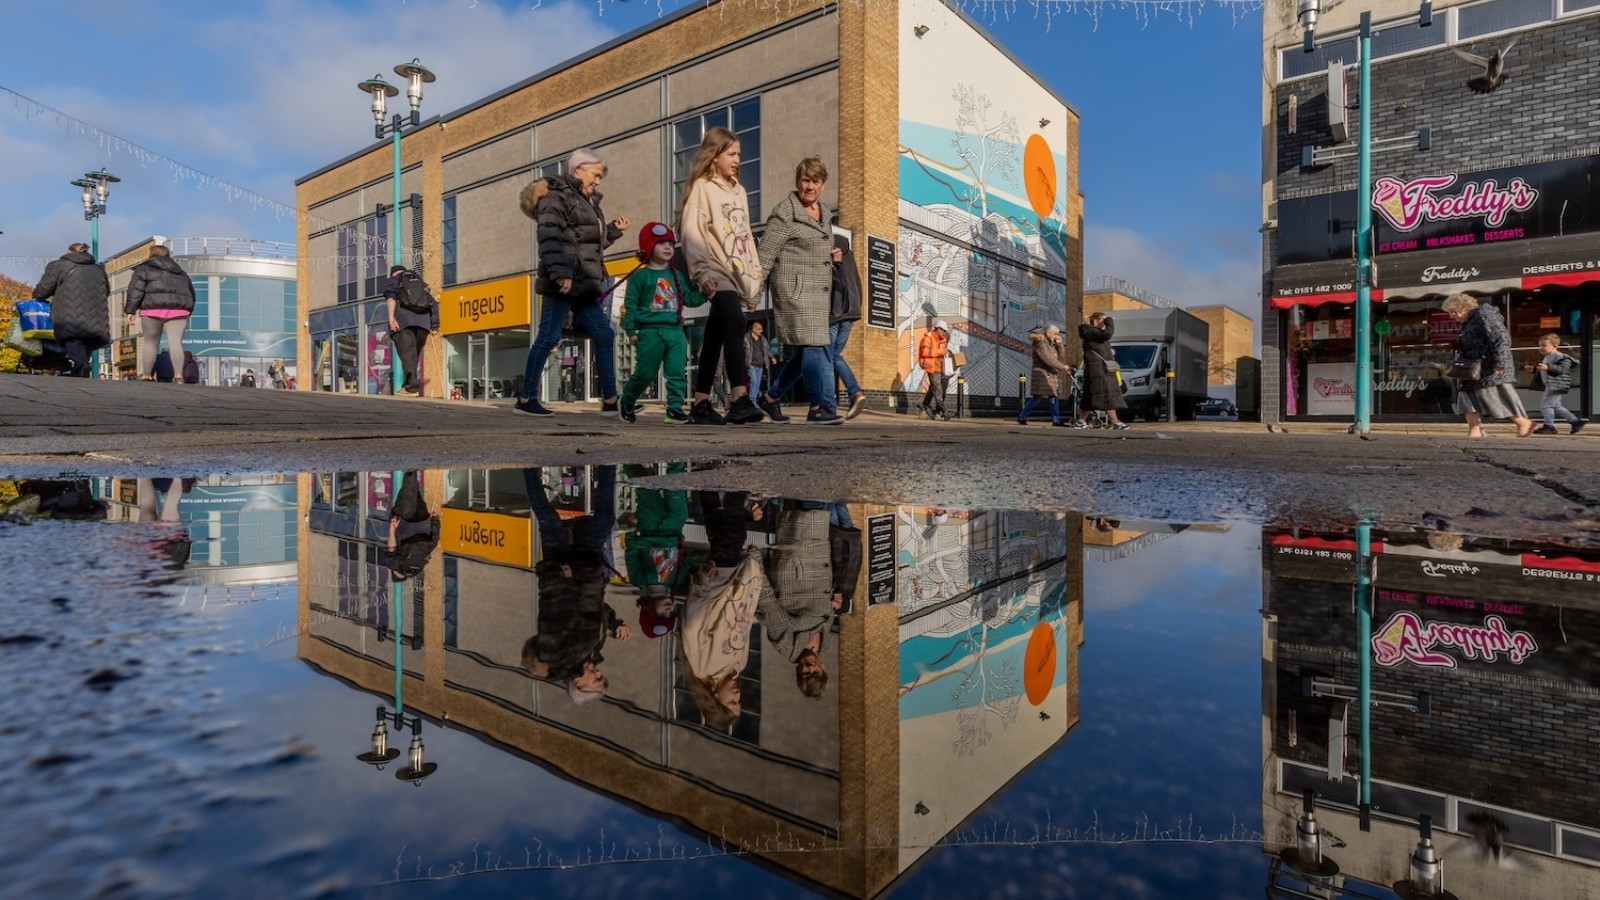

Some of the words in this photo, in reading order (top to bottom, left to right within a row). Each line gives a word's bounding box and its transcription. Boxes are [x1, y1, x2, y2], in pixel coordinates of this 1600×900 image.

[1401, 174, 1537, 229] Freddy's
[1379, 241, 1391, 252] ICE
[1392, 240, 1417, 251] CREAM
[1426, 234, 1475, 247] MILKSHAKES
[1484, 228, 1525, 241] DESSERTS
[1421, 265, 1480, 283] Freddy's
[1522, 262, 1584, 275] DESSERTS
[1586, 261, 1595, 269] &
[1279, 288, 1293, 296] Tel:
[1294, 286, 1313, 294] 0151
[1314, 285, 1330, 293] 482
[1332, 283, 1352, 291] 1009
[459, 295, 505, 322] ingeus
